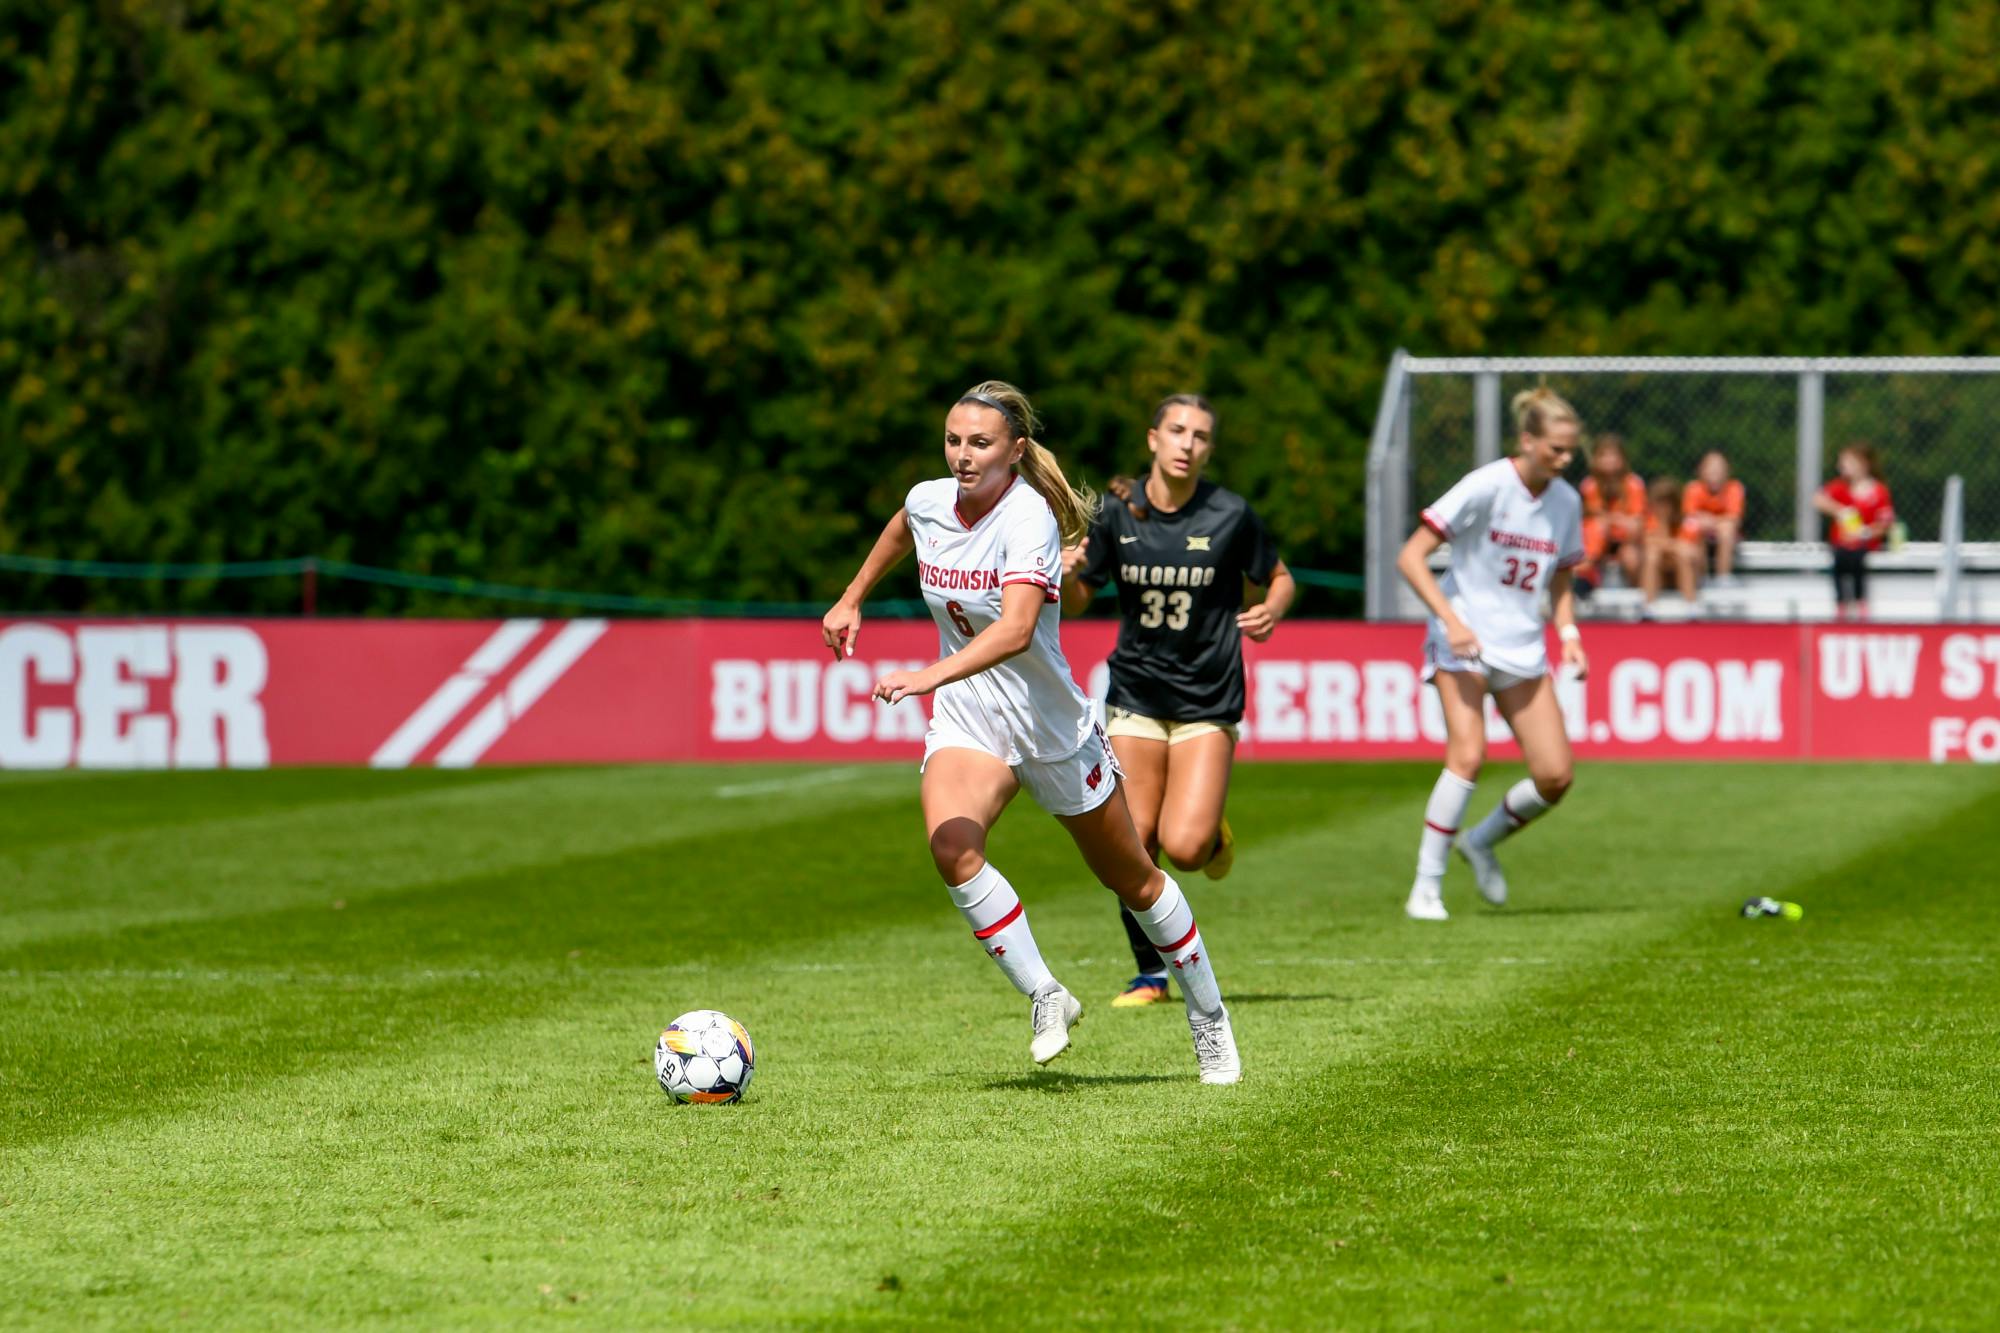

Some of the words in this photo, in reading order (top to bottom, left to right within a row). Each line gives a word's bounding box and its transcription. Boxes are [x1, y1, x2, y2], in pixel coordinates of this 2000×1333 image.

[918, 560, 1000, 591] WISCONSIN
[1121, 563, 1215, 587] COLORADO
[1501, 556, 1538, 592] 32
[946, 600, 975, 638] 6
[1140, 589, 1192, 631] 33
[1818, 633, 1923, 699] UW
[0, 623, 270, 768] CER
[1929, 716, 2000, 764] FO
